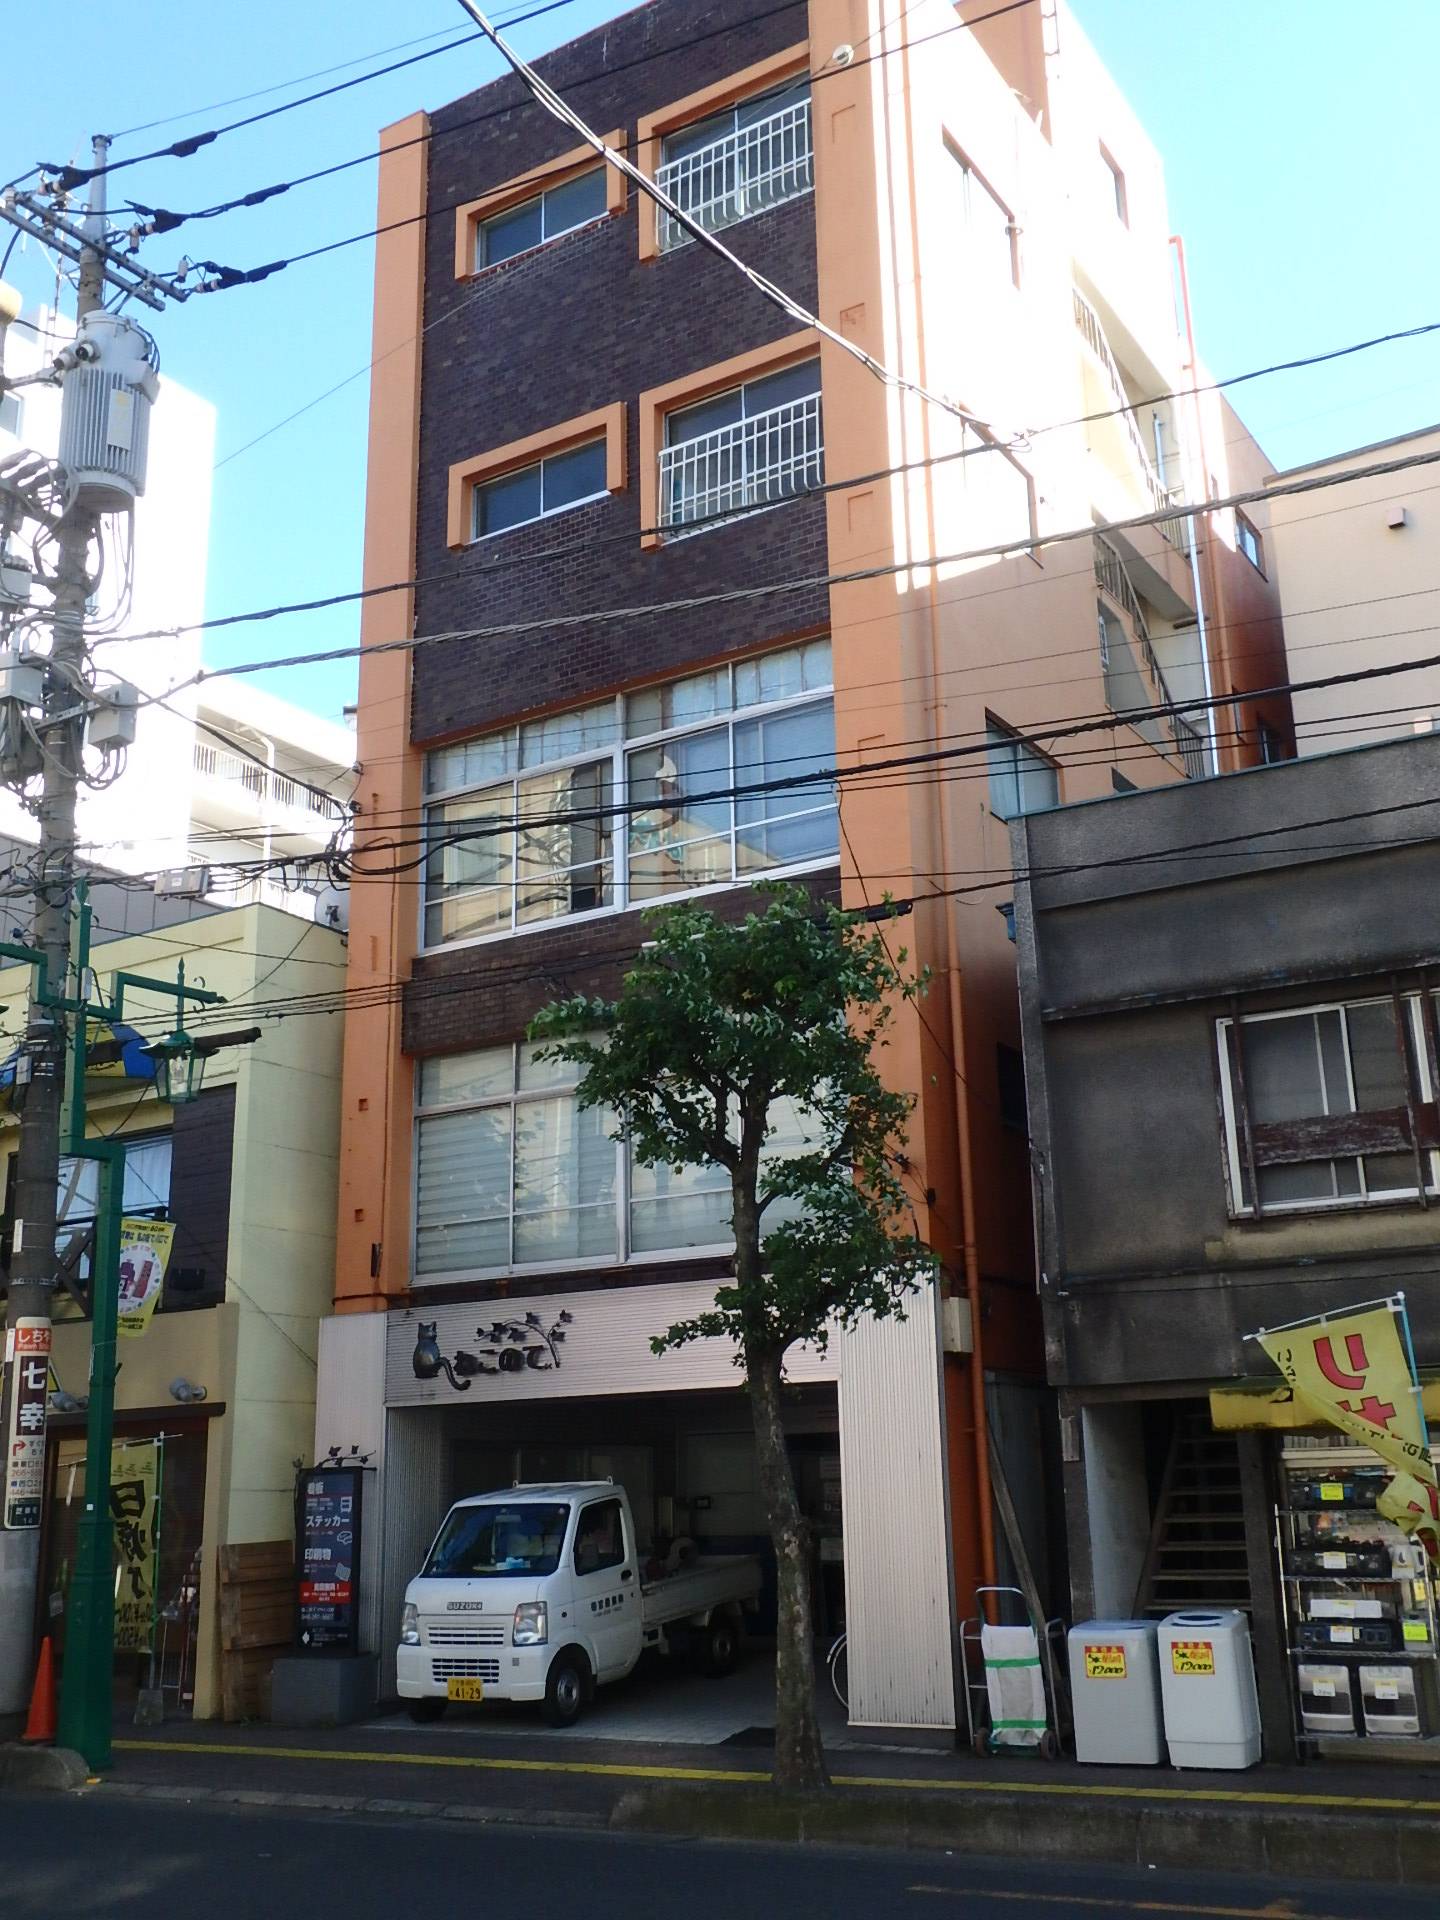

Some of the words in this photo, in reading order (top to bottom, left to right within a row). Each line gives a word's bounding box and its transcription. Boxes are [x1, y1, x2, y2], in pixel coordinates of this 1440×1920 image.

[19, 1362, 46, 1431] 七幸
[306, 1515, 350, 1528] ステッカー
[447, 1602, 482, 1611] SUZUKI
